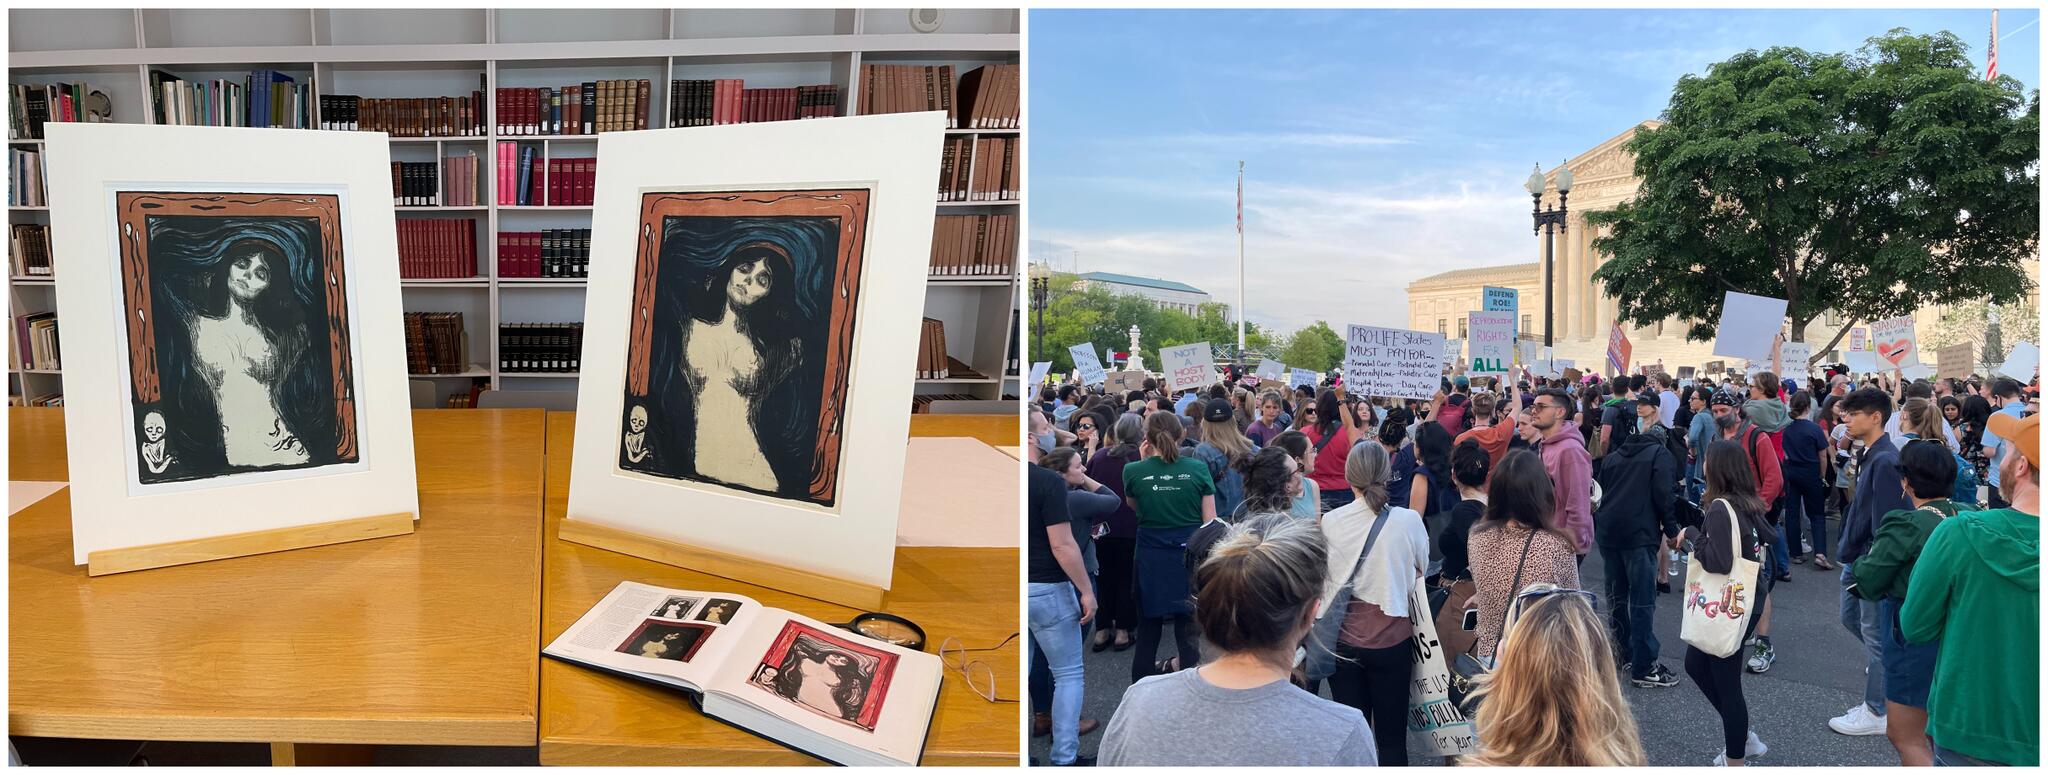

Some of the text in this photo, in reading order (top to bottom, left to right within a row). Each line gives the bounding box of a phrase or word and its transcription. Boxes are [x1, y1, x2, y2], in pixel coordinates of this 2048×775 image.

[1489, 290, 1514, 298] DEFEND
[1492, 299, 1511, 307] ROE!
[1872, 317, 1913, 332] STANDING
[1402, 333, 1432, 346] States
[1476, 329, 1508, 342] RIGHTS
[1173, 347, 1197, 358] NOT
[1350, 345, 1379, 357] MUST
[1387, 348, 1407, 360] PAY
[1483, 345, 1500, 356] FOR
[1174, 364, 1204, 377] HOST
[1472, 358, 1509, 372] ALL
[1176, 374, 1206, 386] BODY
[1350, 369, 1380, 379] Maternity
[1350, 378, 1372, 387] Hospital
[1401, 381, 1416, 390] Day
[1418, 382, 1434, 390] Care
[1687, 579, 1745, 619] VOGUE
[1415, 678, 1432, 695] THE
[1429, 701, 1466, 727] BILLIO
[1432, 731, 1472, 752] Per year
